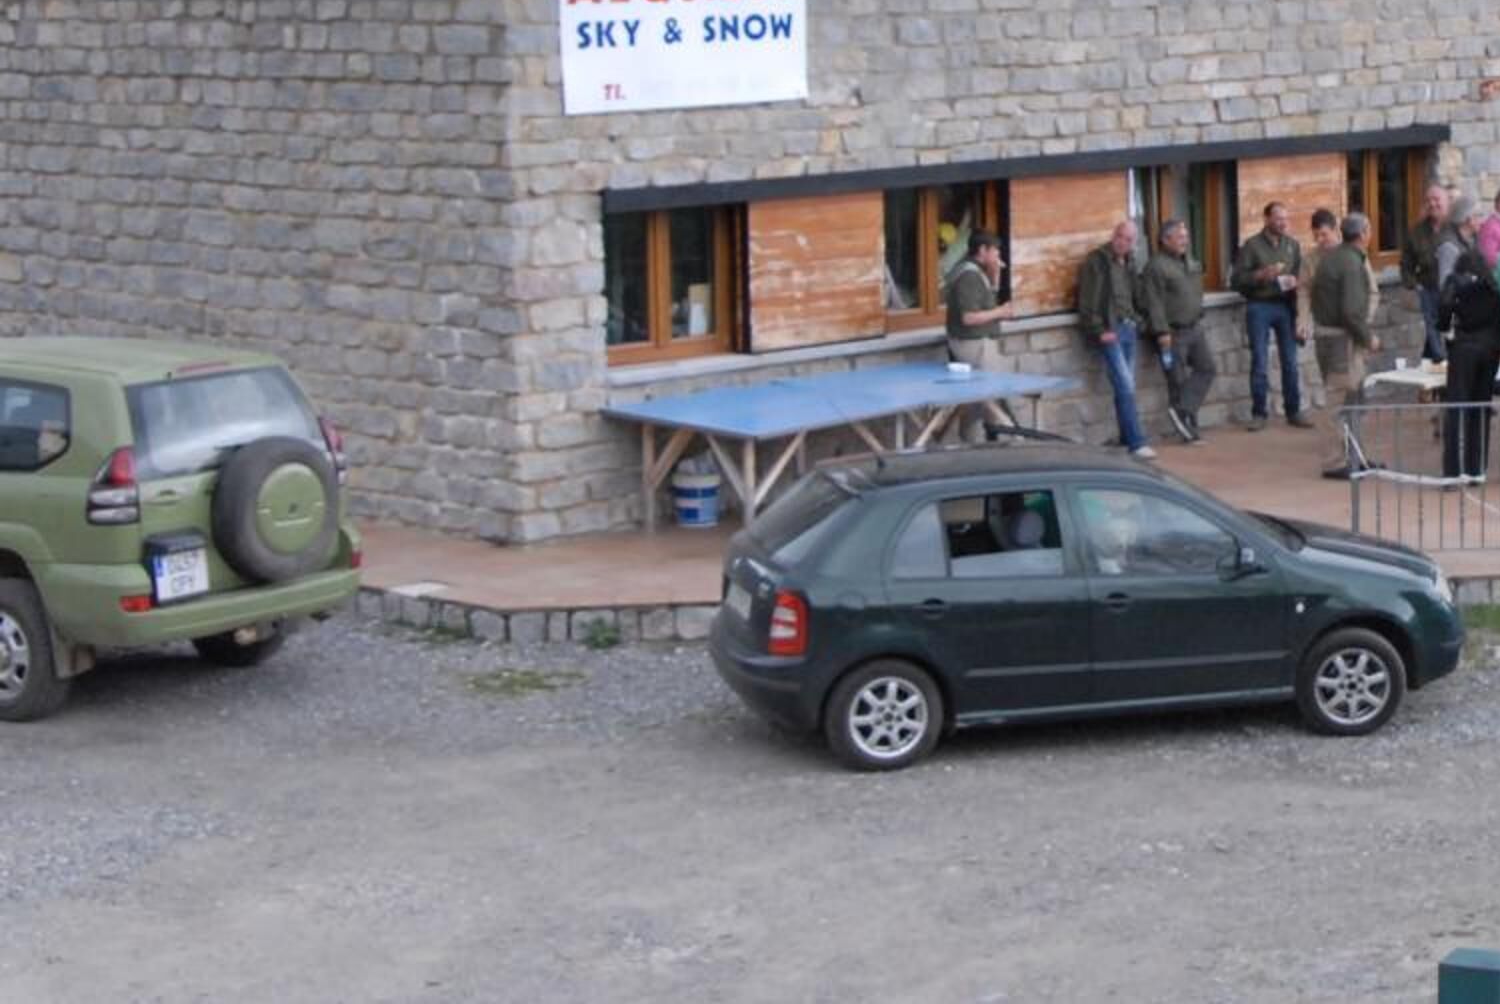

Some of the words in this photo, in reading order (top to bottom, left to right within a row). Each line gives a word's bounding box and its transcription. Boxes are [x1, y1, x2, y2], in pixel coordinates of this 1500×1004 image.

[577, 19, 640, 48] SKY
[663, 17, 682, 44] &
[703, 13, 793, 43] SNOW
